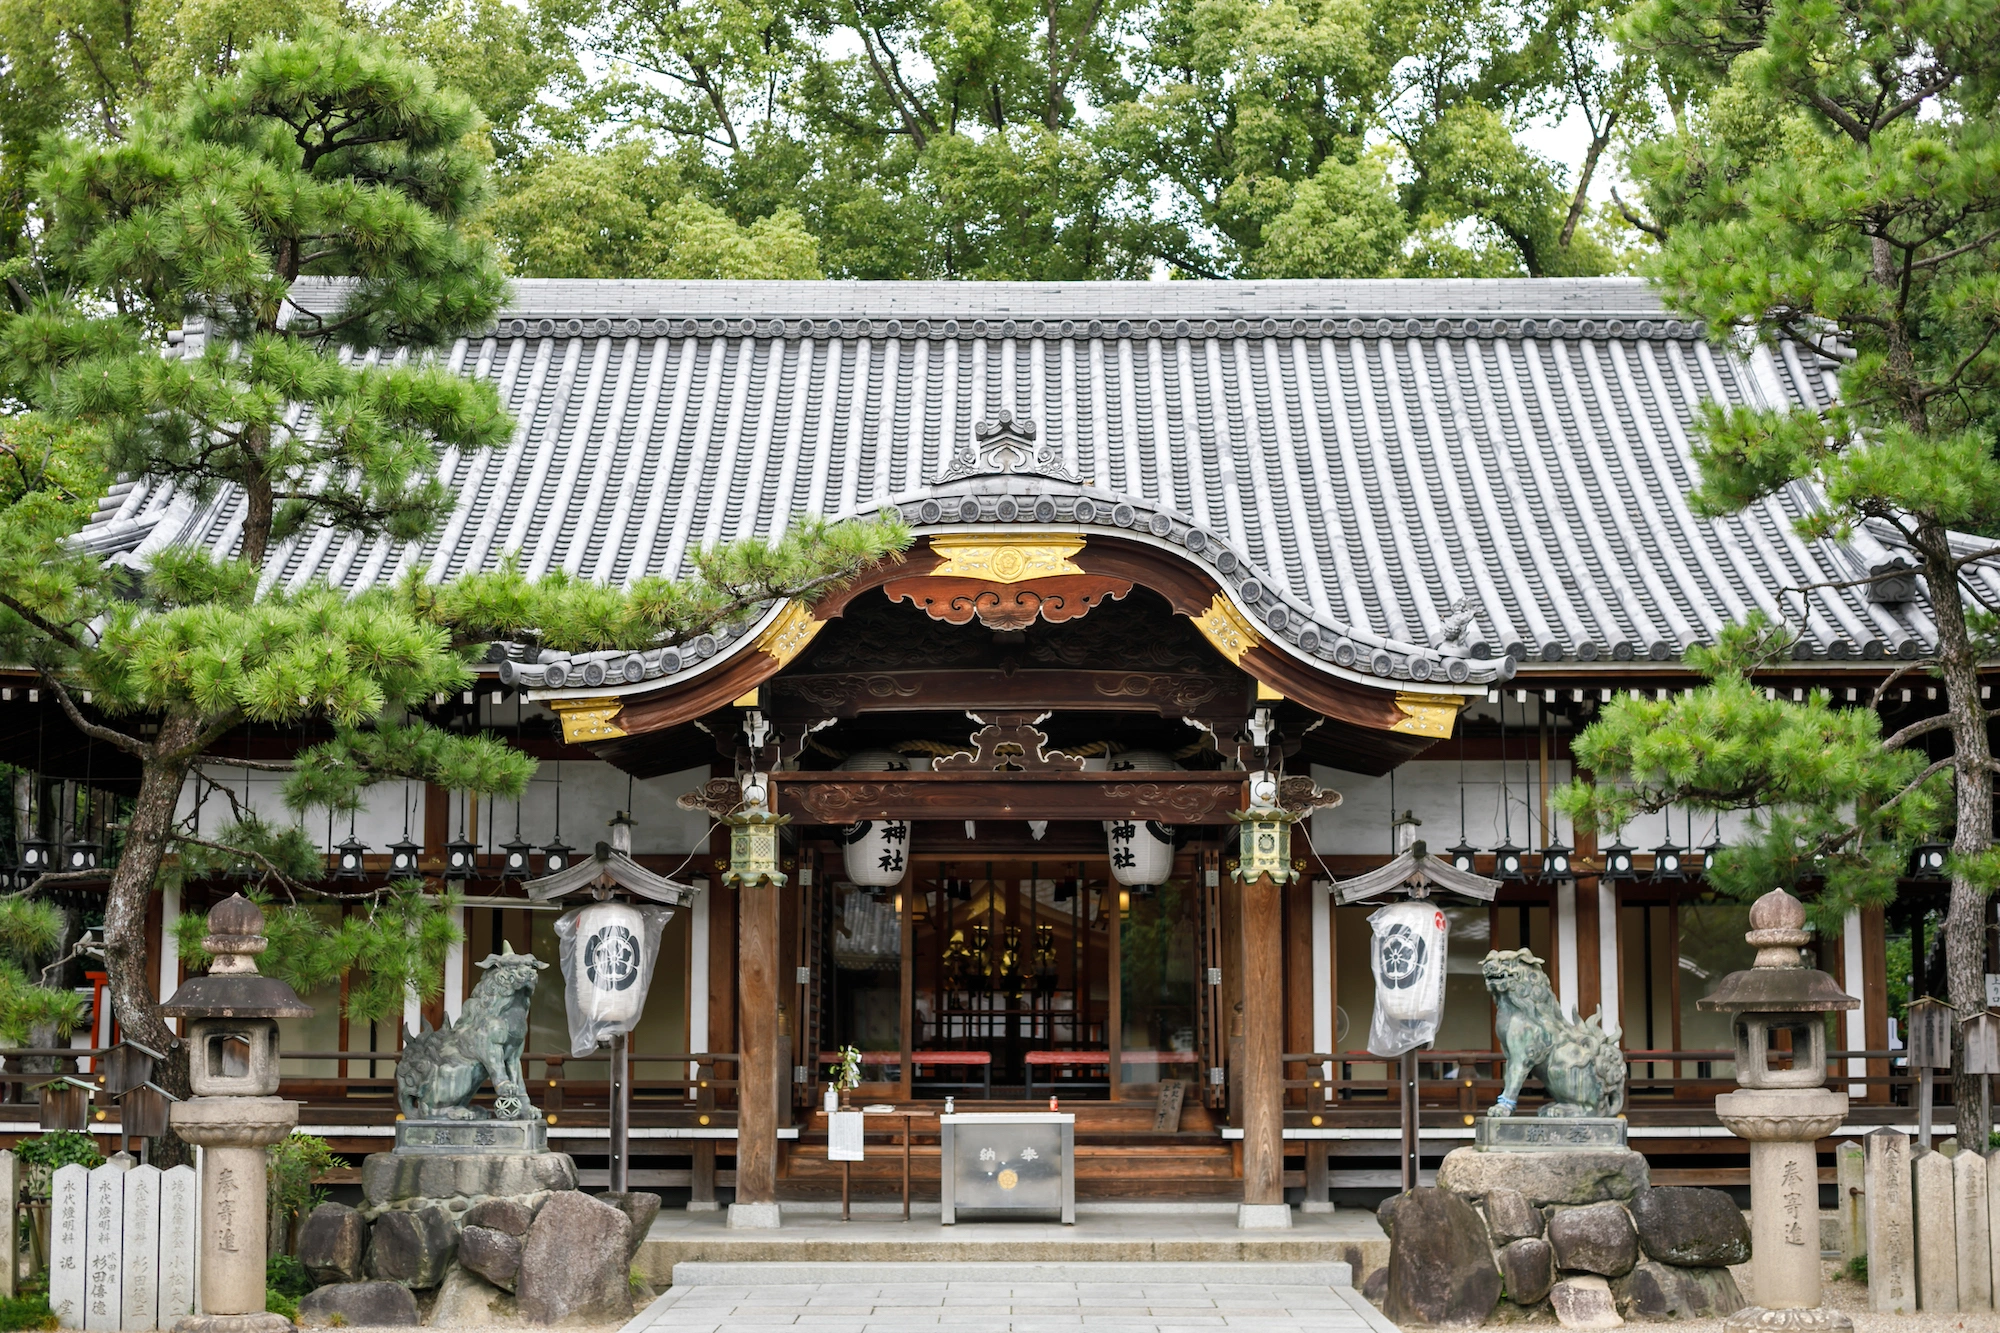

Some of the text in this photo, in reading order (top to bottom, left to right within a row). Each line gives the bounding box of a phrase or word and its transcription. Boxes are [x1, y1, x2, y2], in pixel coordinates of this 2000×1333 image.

[215, 1168, 240, 1253] 奉寄進
[1780, 1160, 1805, 1246] 奉寄進
